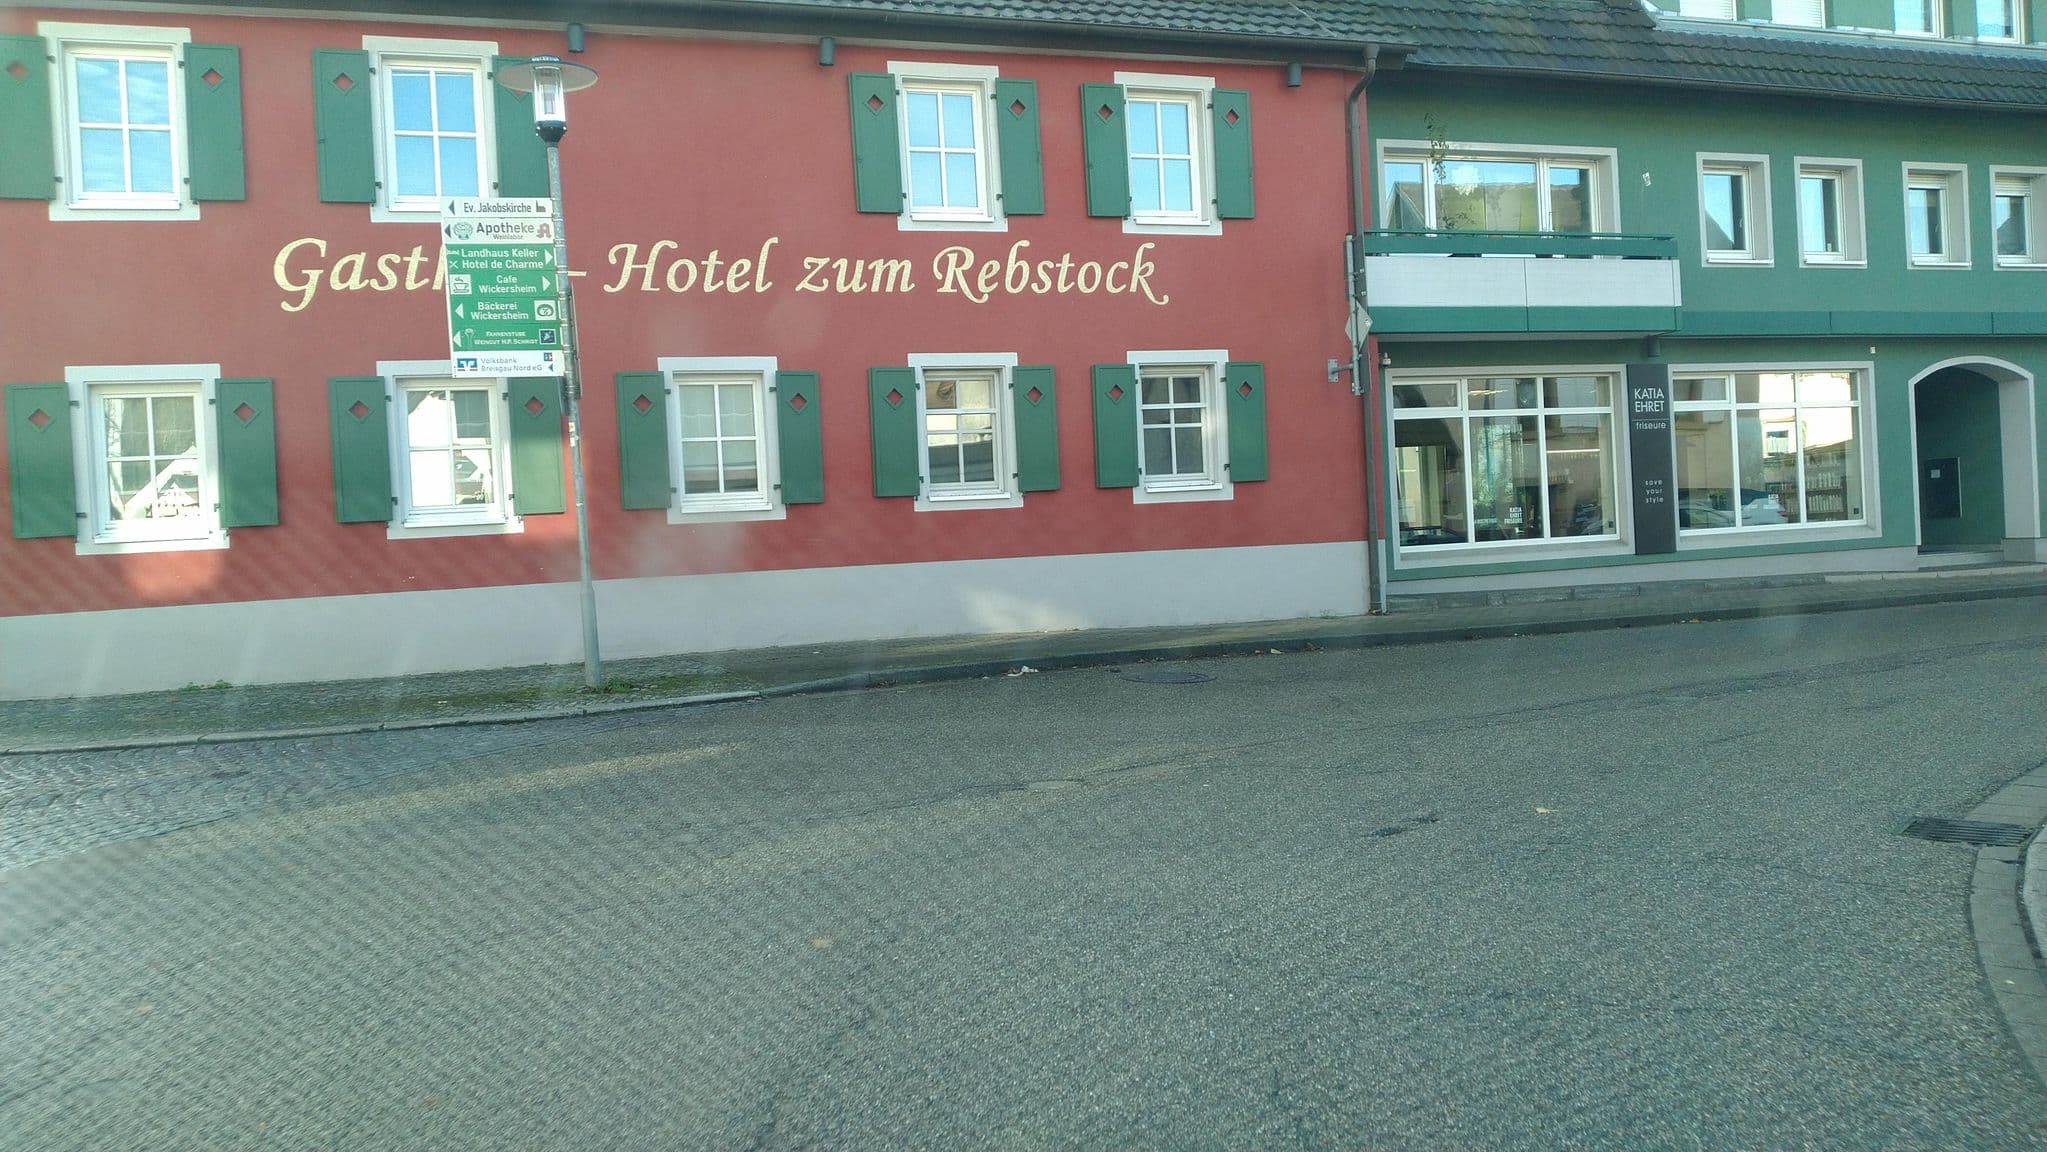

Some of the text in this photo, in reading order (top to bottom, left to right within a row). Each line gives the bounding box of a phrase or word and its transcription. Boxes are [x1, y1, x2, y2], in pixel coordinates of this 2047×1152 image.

[463, 202, 532, 213] Ev. Jakobskirche
[476, 221, 535, 235] Apotheke
[461, 248, 540, 258] Landhaus Keller
[462, 260, 544, 269] Hotel de Charme
[603, 237, 779, 293] Hotel
[794, 255, 915, 292] zum
[932, 239, 1170, 306] Rebstock
[496, 275, 518, 284] Cafe
[478, 284, 537, 294] Wickersheim
[477, 301, 518, 311] Bäckerei
[470, 311, 529, 320] Wickersheim
[1635, 401, 1665, 413] EHRET
[1636, 421, 1667, 431] friseure
